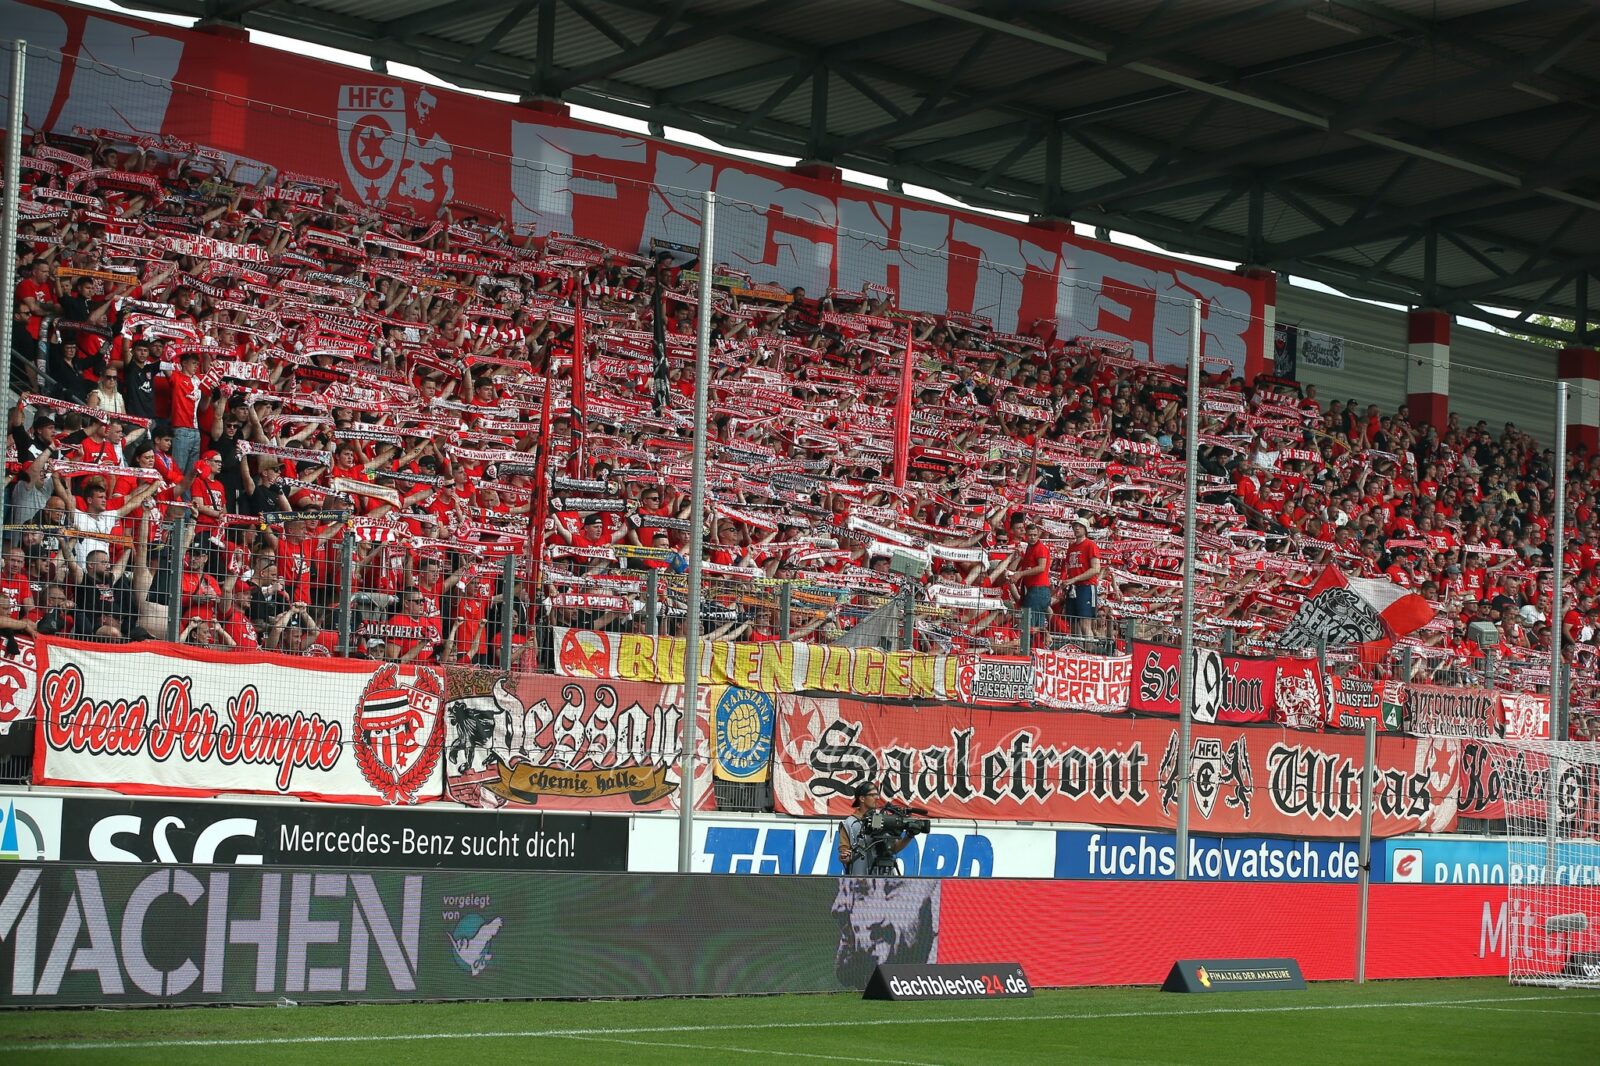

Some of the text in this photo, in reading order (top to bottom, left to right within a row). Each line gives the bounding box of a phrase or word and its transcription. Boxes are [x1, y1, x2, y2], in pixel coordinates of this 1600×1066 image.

[348, 86, 394, 109] HFC
[565, 595, 625, 610] HFC CHEMIE
[1352, 611, 1375, 636] HFC
[978, 663, 1031, 683] SEKTION
[1341, 678, 1374, 692] SEKTION
[1335, 690, 1381, 709] MANSFELD
[40, 662, 344, 792] Coesa Per Sempre
[1197, 742, 1219, 758] HFC
[808, 720, 1151, 806] Saalefront
[528, 769, 640, 794] chemie halle
[279, 823, 577, 859] Mercedes-Benz sucht dich!
[1086, 833, 1359, 880] fuchskovatsch.de
[1434, 863, 1504, 884] RADIO
[443, 893, 490, 909] vorgelegt
[442, 911, 460, 920] von
[889, 974, 1029, 996] dachbleche24.de
[1208, 969, 1292, 981] FINALTAG DER AMATEURE
